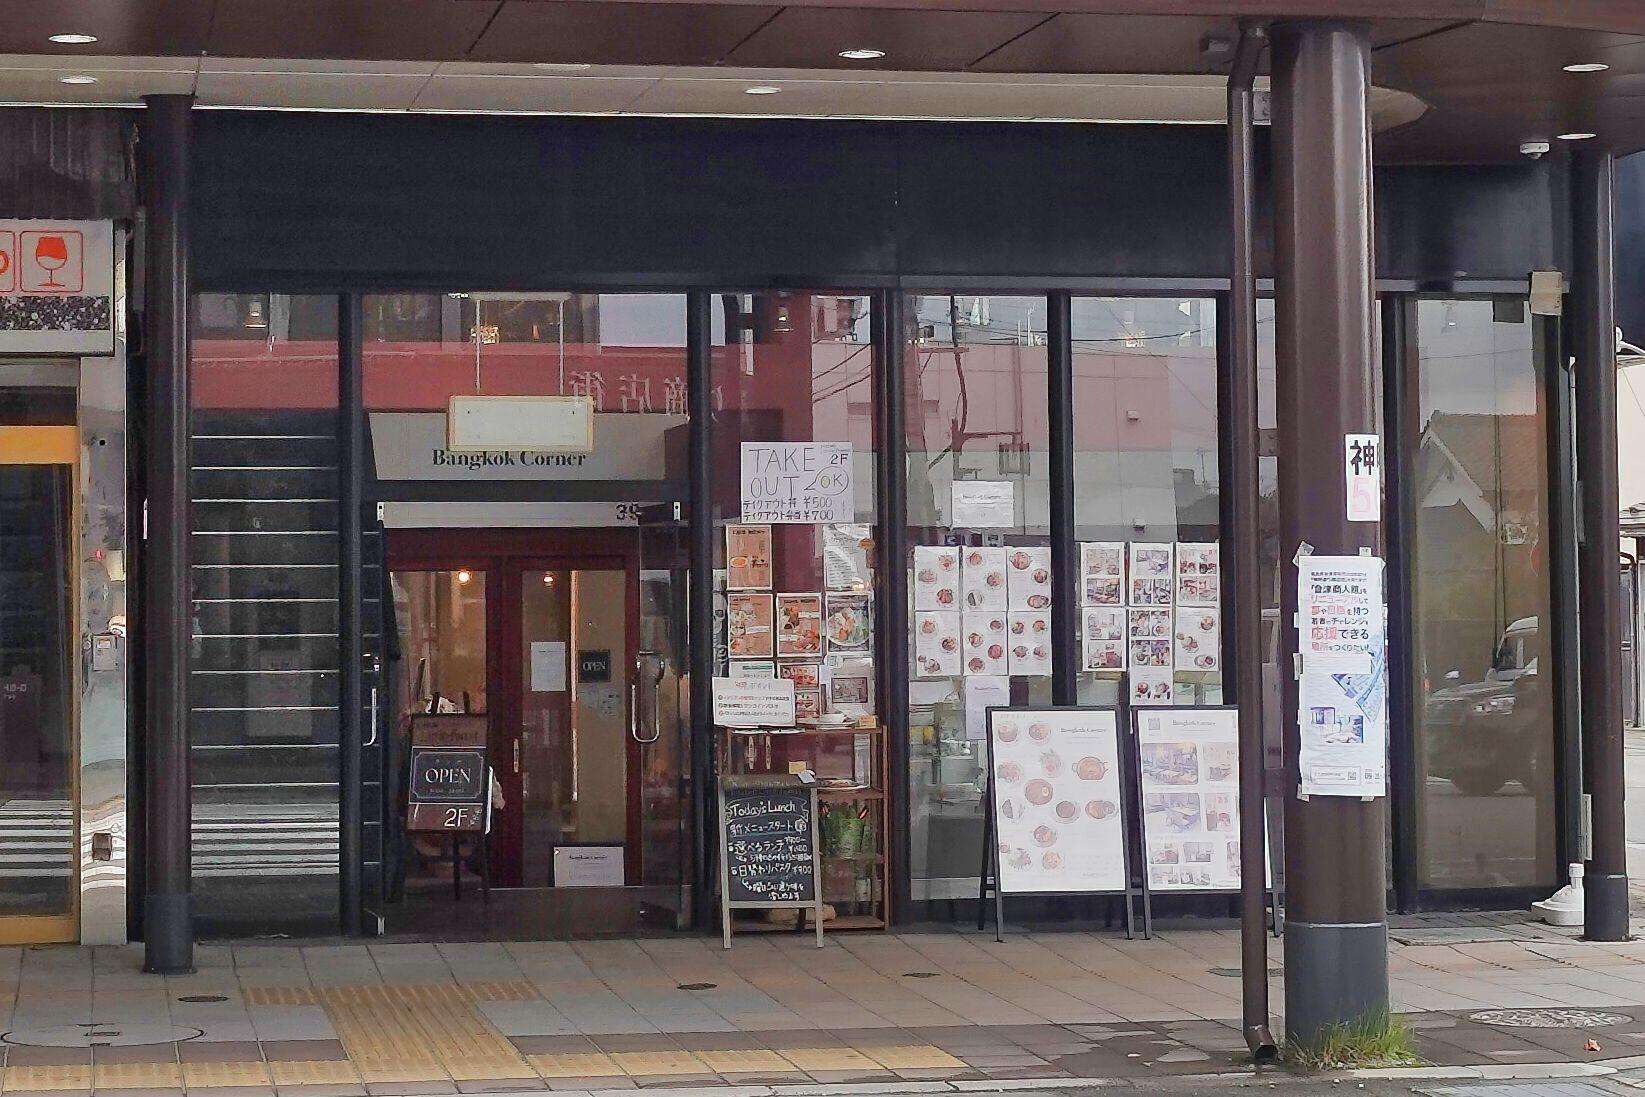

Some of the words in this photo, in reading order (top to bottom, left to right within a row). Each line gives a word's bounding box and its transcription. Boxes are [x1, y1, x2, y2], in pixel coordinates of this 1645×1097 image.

[432, 449, 515, 470] Bangkok
[520, 450, 586, 466] Corner
[748, 447, 815, 473] TAKE
[830, 453, 848, 465] 2F
[750, 476, 800, 499] OUT
[820, 473, 843, 488] OK
[804, 496, 832, 509] ¥500
[803, 509, 834, 521] ¥700
[1311, 626, 1369, 640] 応援できる
[582, 660, 606, 671] OPEN
[425, 768, 472, 784] OPEN
[729, 801, 767, 817] Today's
[768, 800, 796, 813] Lunch
[444, 808, 469, 827] 2F
